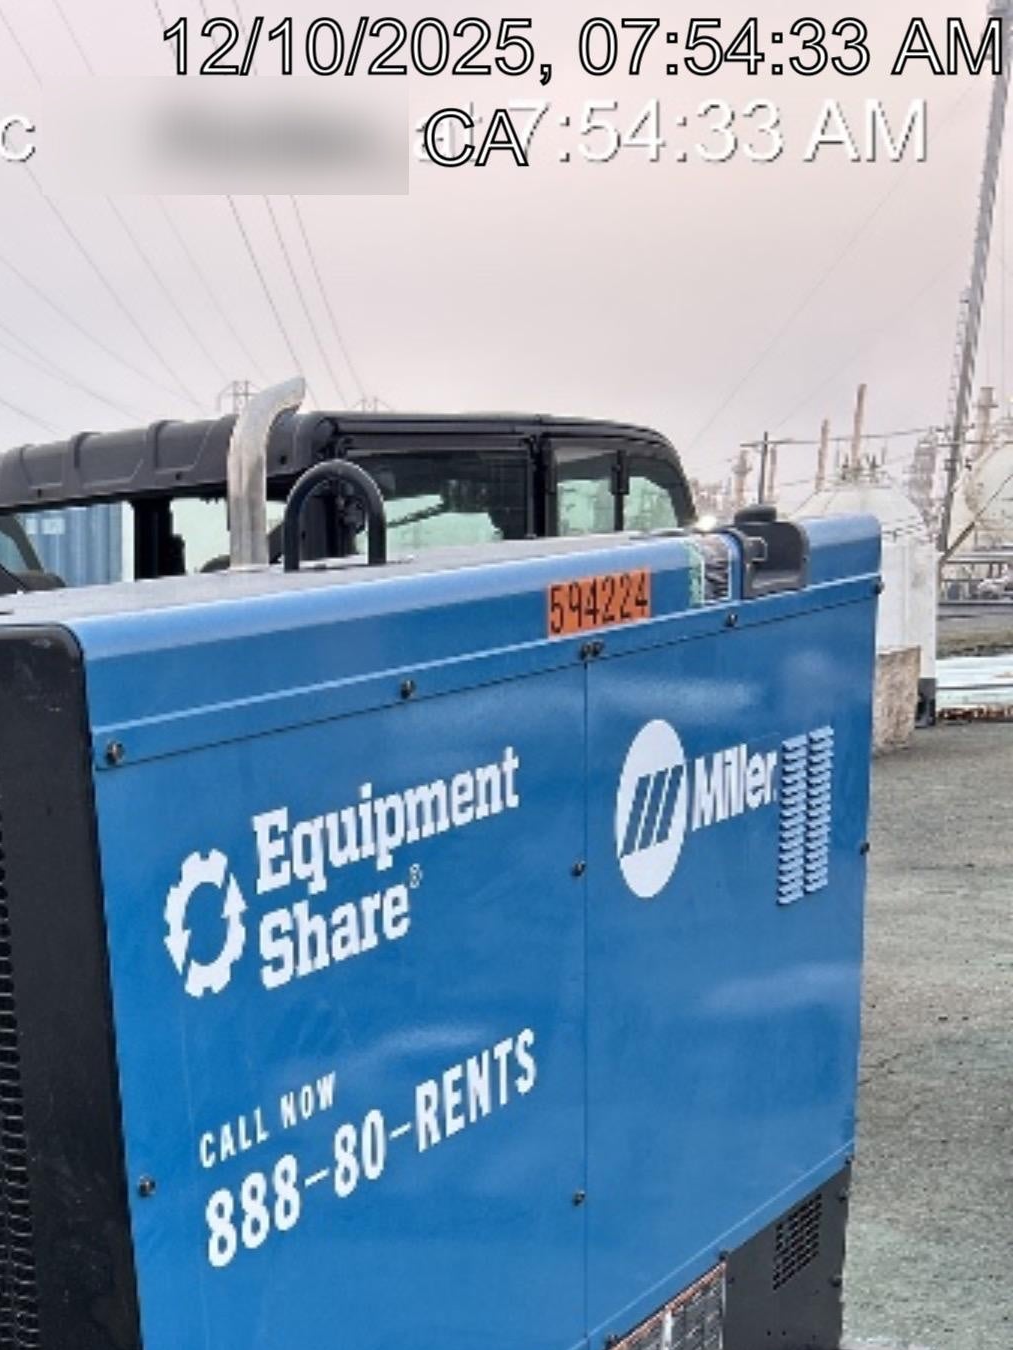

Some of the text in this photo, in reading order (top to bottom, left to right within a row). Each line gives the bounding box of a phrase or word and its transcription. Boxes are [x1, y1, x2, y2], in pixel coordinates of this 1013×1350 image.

[550, 571, 649, 635] 594224
[252, 746, 520, 894] Equipment
[200, 1072, 338, 1169] CALL NOW
[204, 1027, 538, 1268] 888-80-RENTS
